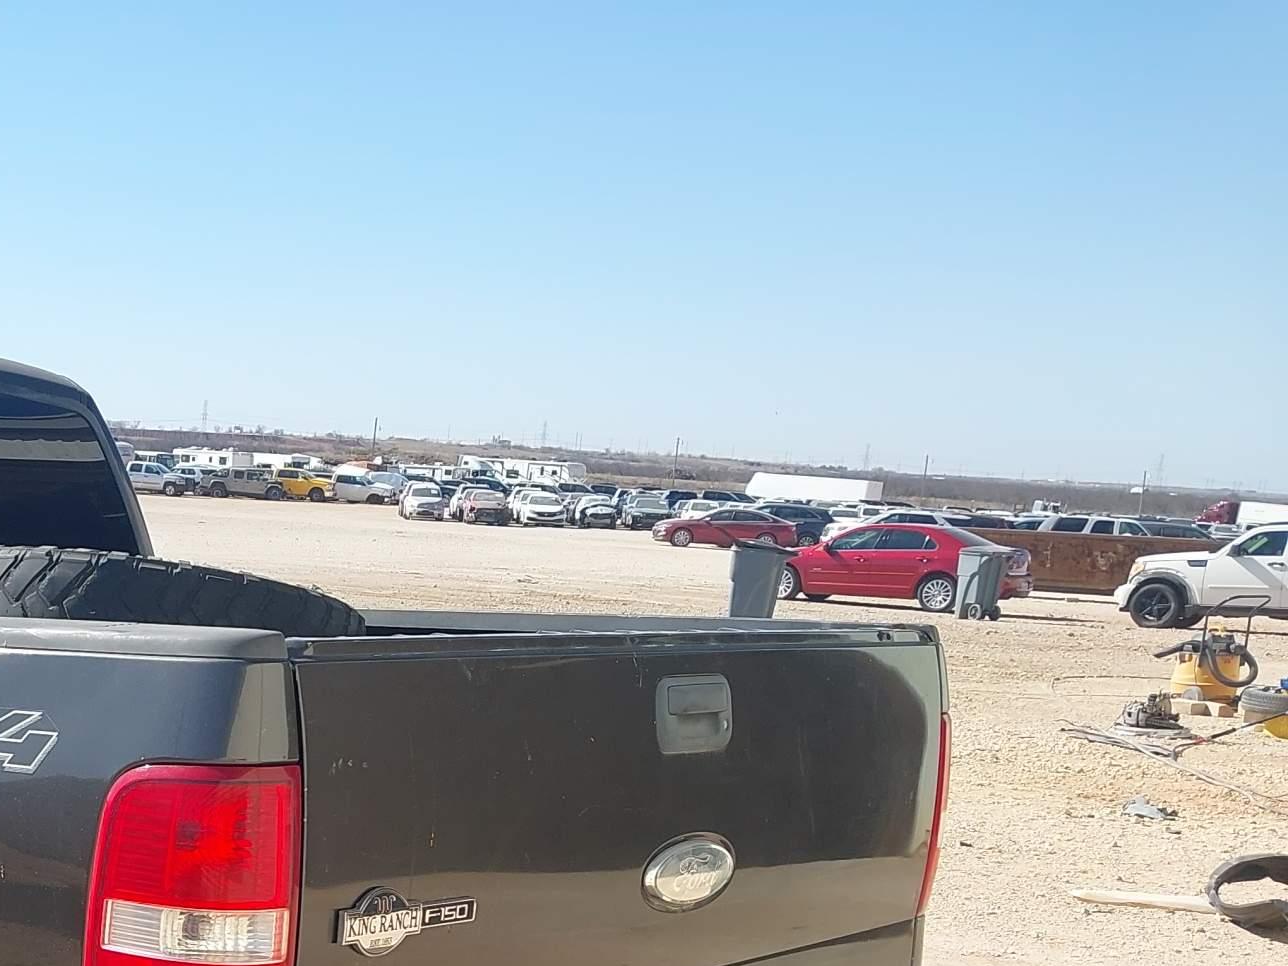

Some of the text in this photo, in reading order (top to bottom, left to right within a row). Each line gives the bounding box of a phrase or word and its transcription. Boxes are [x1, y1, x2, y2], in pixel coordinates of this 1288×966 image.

[674, 854, 722, 892] Ford
[347, 907, 419, 938] KING RANCH
[425, 904, 469, 923] F150
